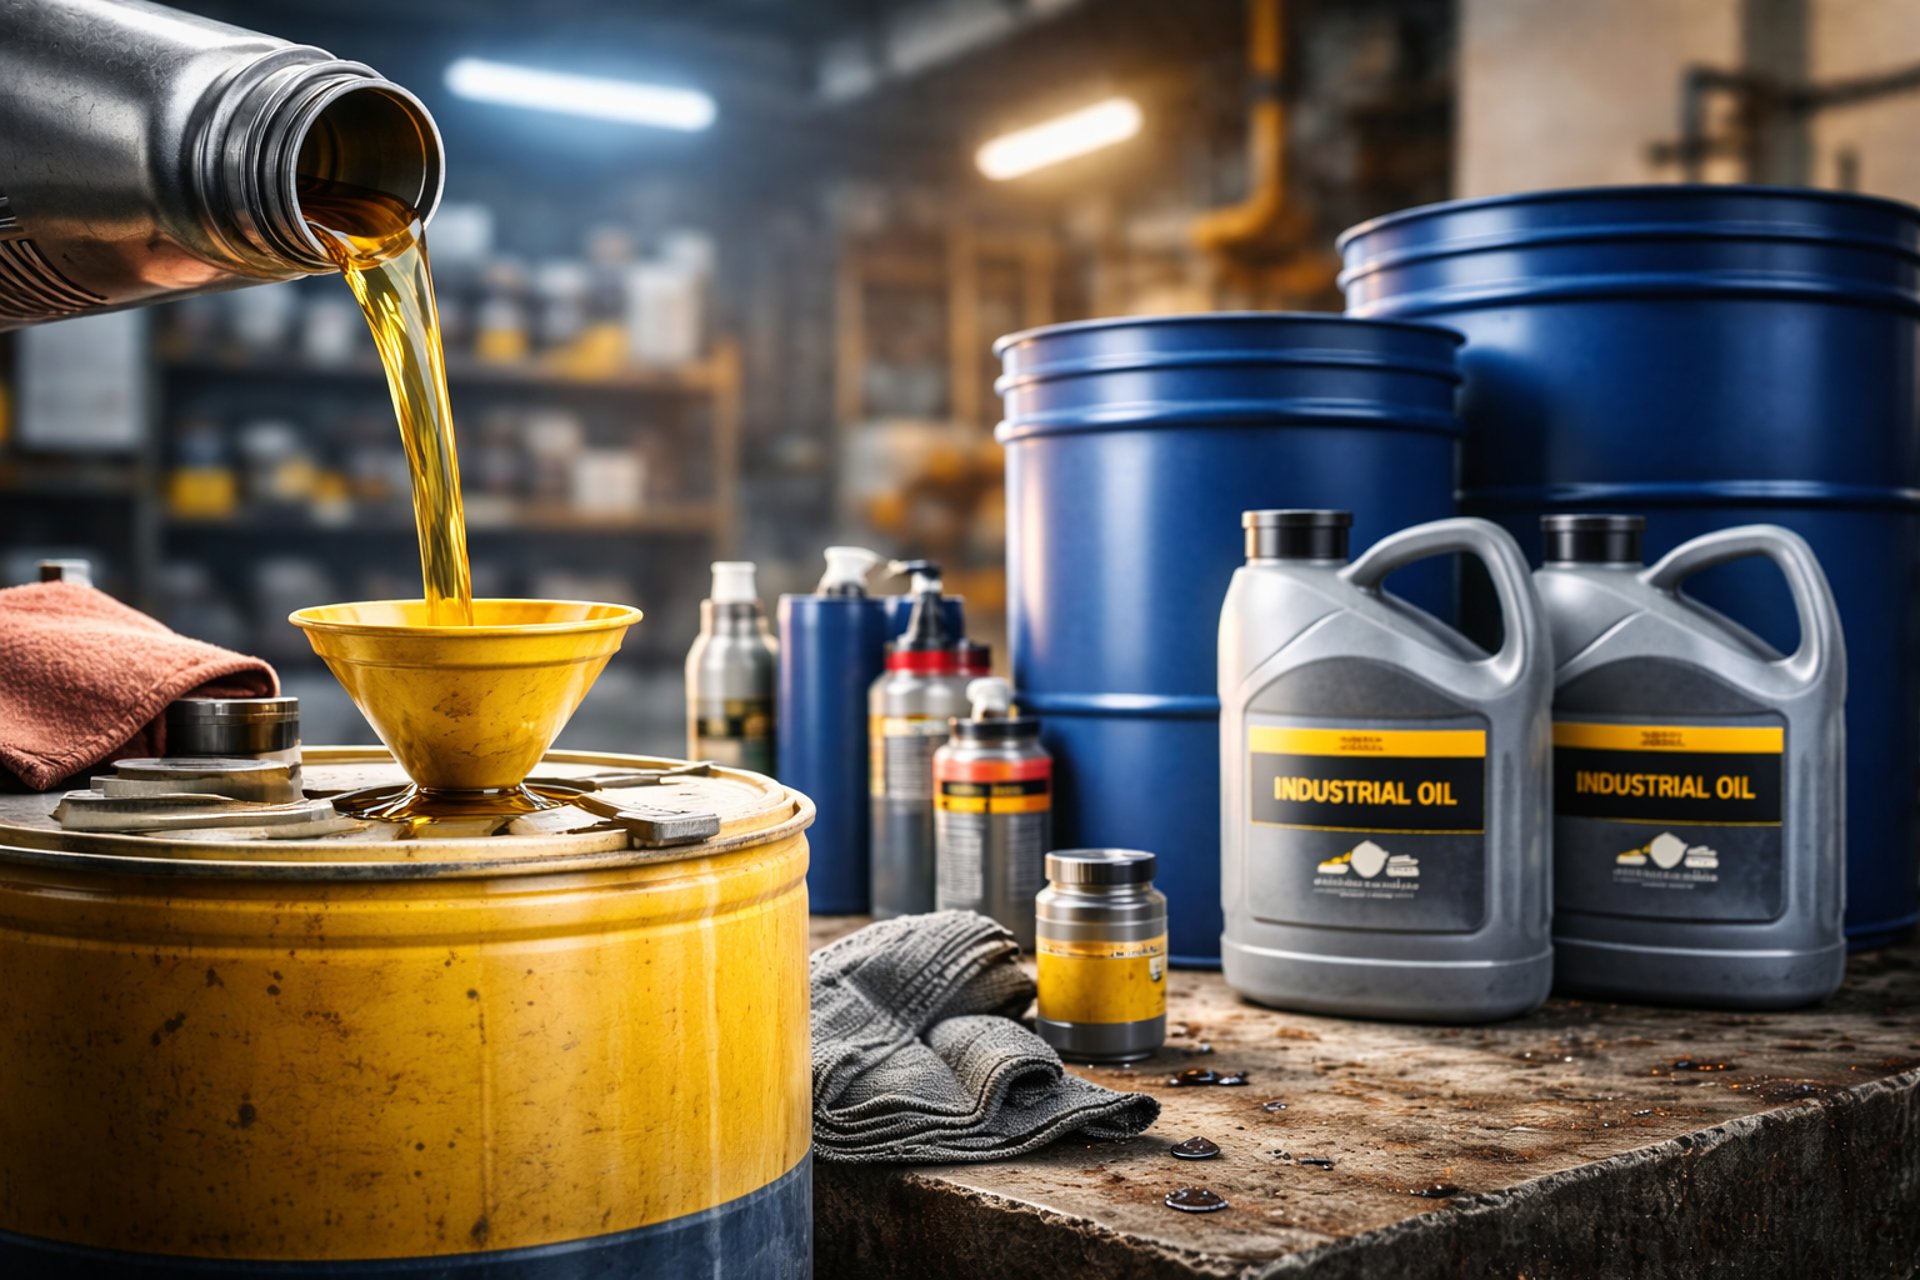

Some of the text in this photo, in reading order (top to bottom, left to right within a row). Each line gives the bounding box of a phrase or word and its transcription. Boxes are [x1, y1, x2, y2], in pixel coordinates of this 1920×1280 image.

[1274, 776, 1457, 805] INDUSTRIAL OIL
[1576, 770, 1756, 799] INDUSTRIAL OIL
